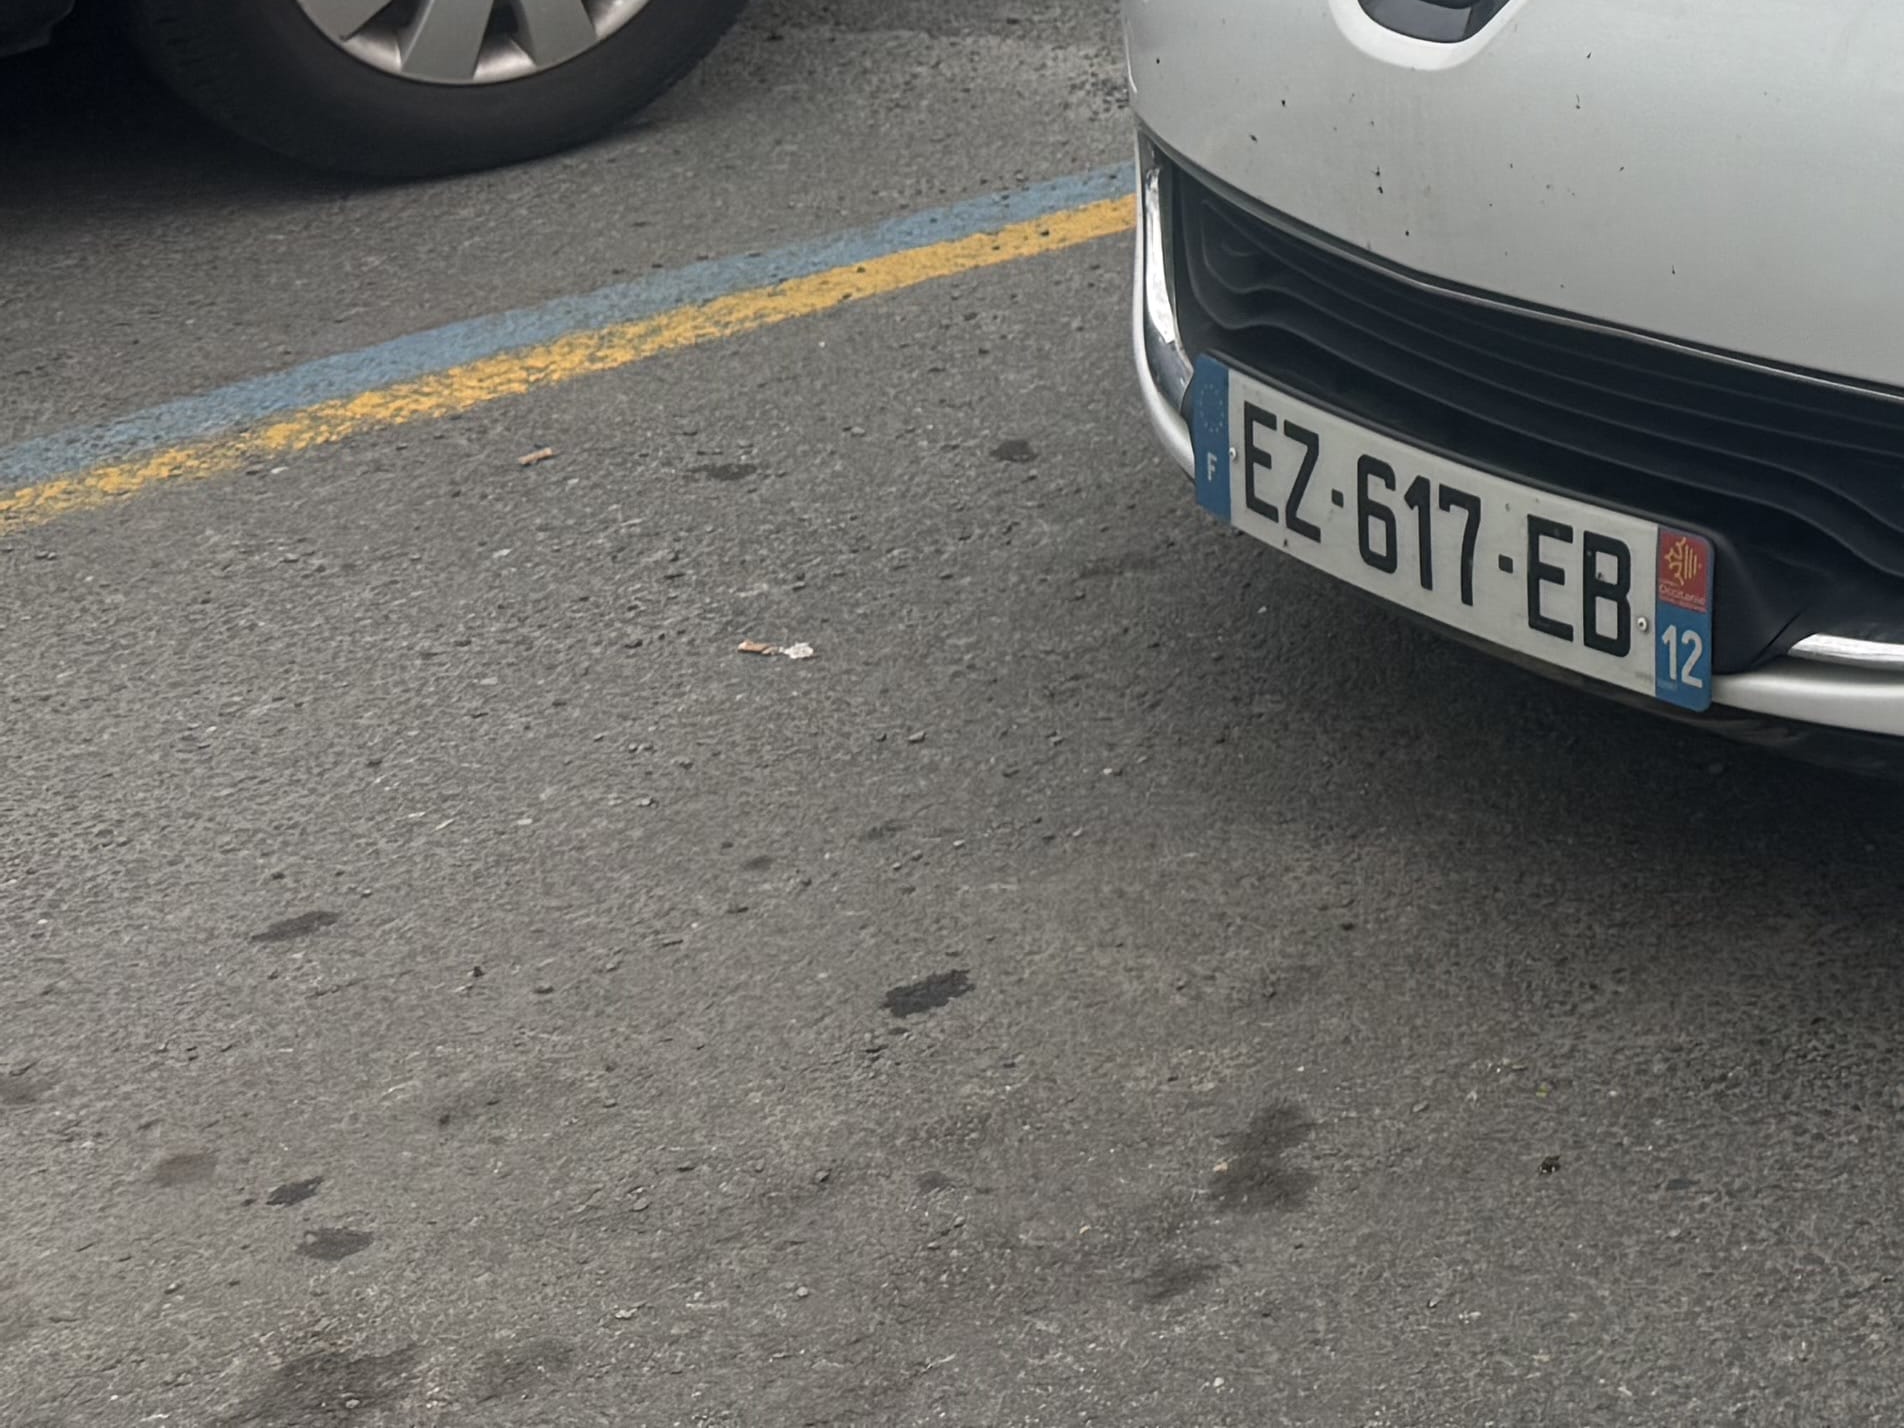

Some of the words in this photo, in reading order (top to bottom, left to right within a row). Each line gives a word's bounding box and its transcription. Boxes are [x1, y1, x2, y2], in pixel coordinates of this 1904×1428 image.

[1207, 451, 1218, 482] F
[1243, 400, 1633, 658] EZ-617-EB
[1661, 623, 1703, 689] 12
